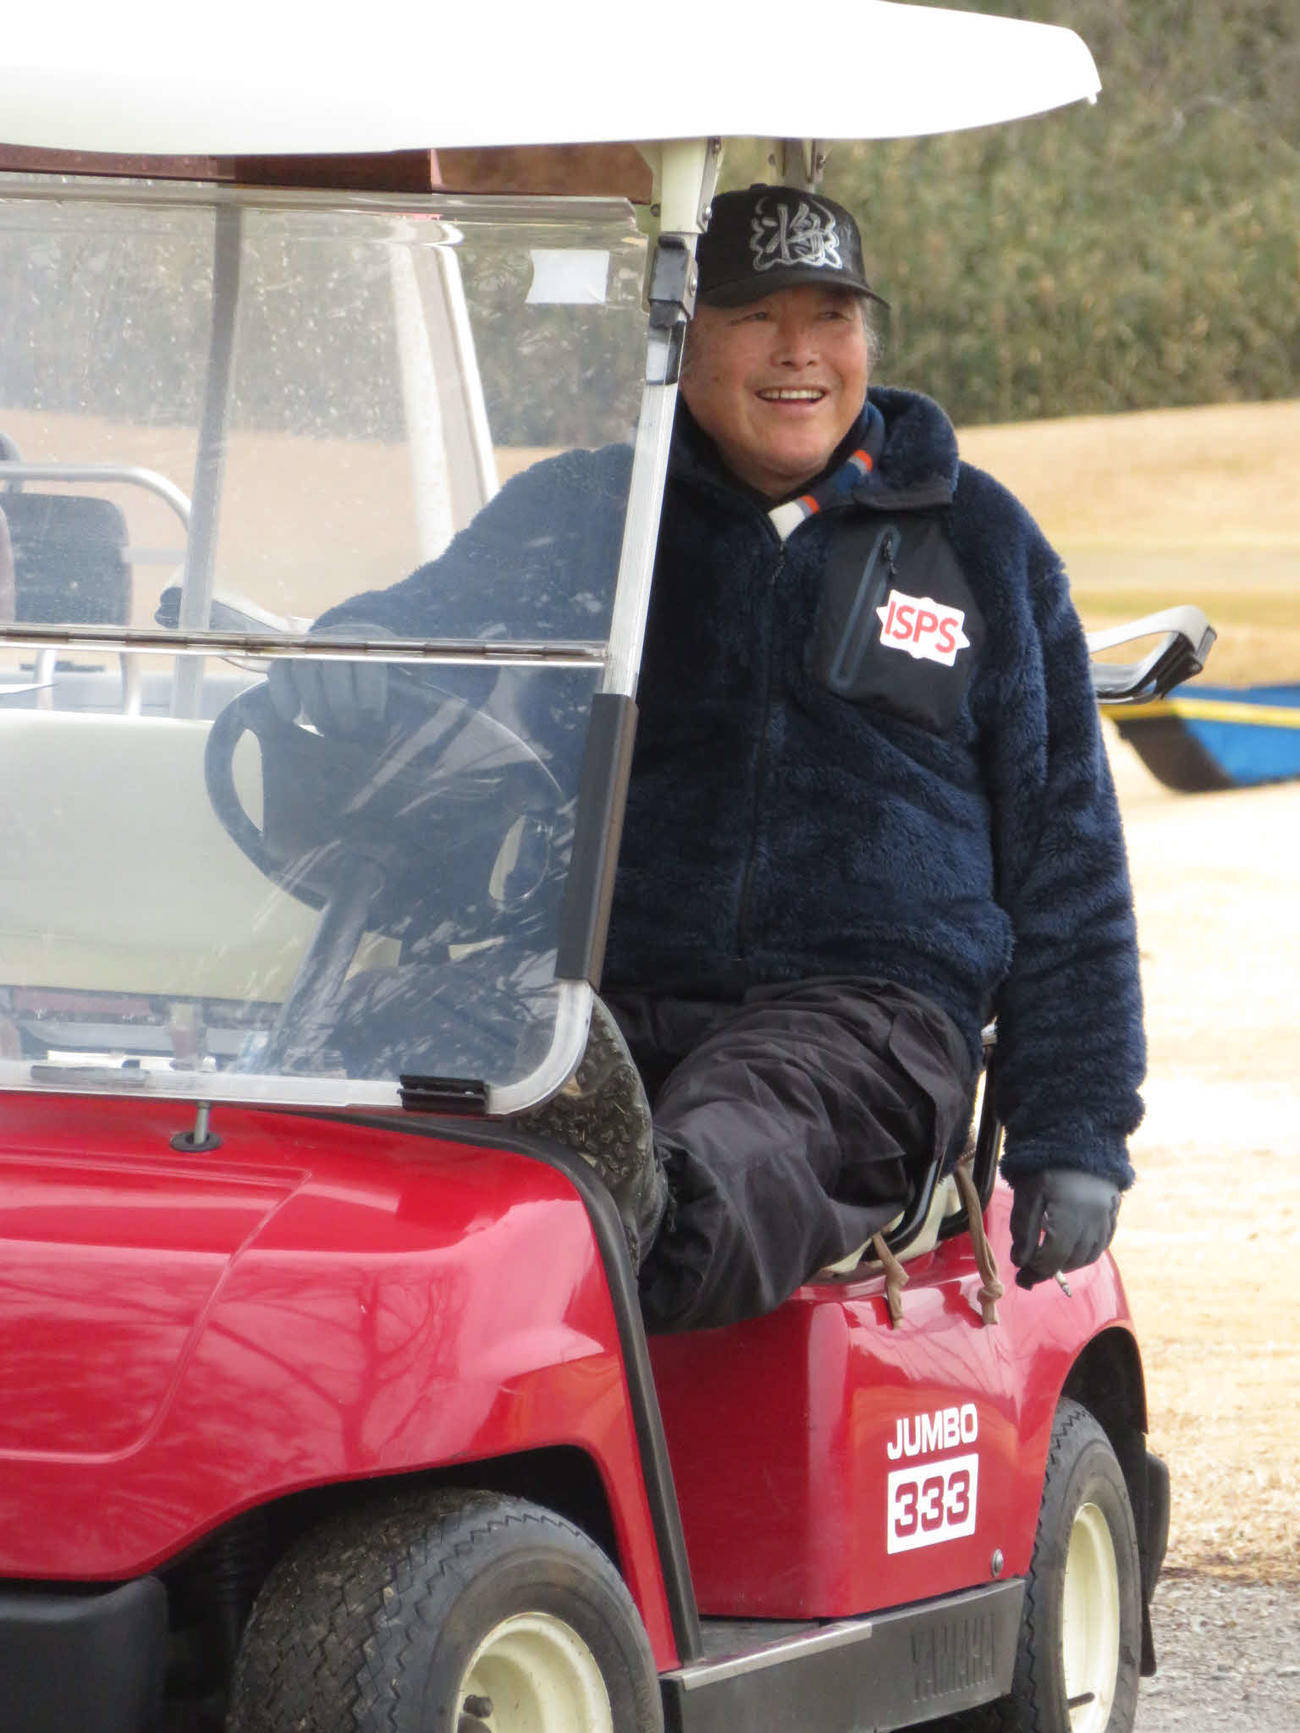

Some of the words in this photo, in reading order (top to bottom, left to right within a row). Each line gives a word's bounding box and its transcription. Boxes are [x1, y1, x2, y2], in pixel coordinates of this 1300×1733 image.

[885, 600, 959, 653] ISPS
[887, 1403, 978, 1460] JUMBO
[894, 1469, 970, 1538] 333
